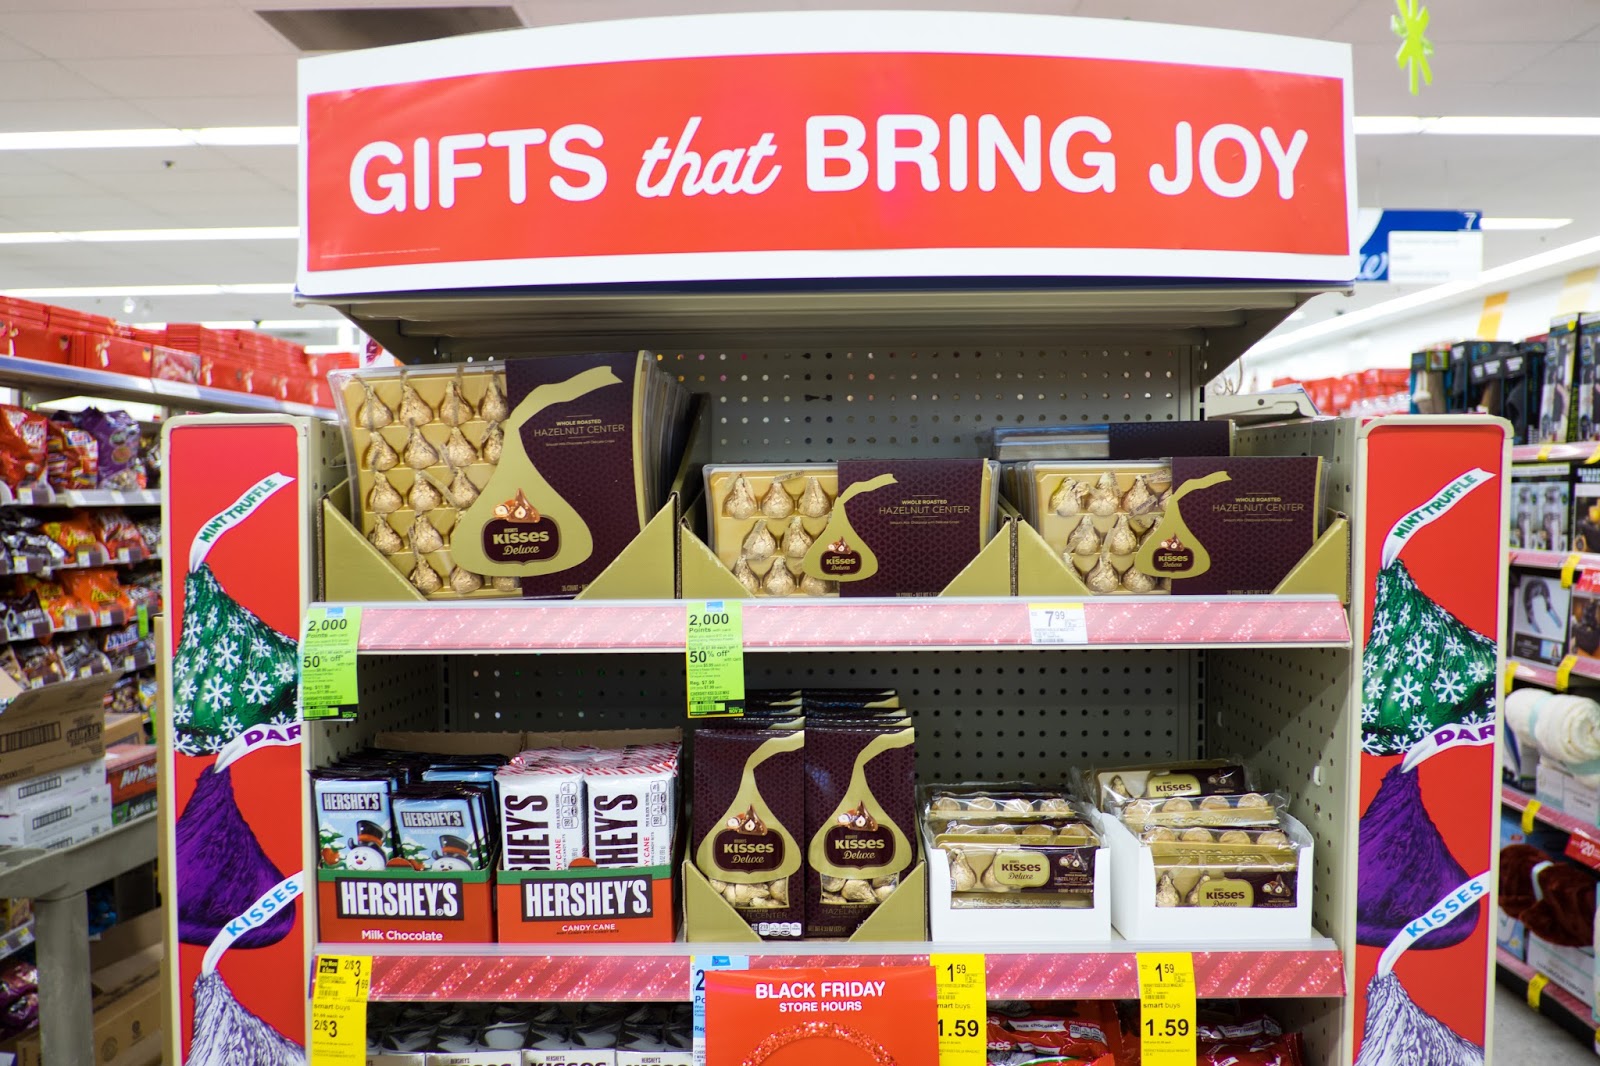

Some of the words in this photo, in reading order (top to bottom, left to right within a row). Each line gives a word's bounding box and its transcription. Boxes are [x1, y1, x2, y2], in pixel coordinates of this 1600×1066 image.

[350, 124, 608, 215] GIFTS
[635, 116, 782, 198] that
[805, 114, 1116, 193] BRING
[1148, 121, 1308, 200] JOY
[1463, 211, 1477, 231] 7
[534, 427, 584, 437] HAZELNUT
[587, 424, 625, 434] CENTER
[199, 515, 227, 544] MINT
[224, 479, 278, 521] TRUFFLE
[880, 506, 929, 514] HAZELNUT
[932, 505, 970, 514] CENTER
[1212, 504, 1263, 512] HAZELNUT
[1265, 504, 1304, 512] CENTER
[1393, 509, 1425, 540] MINT
[1423, 474, 1478, 517] TRUFFLE
[502, 544, 540, 556] Deluxe
[308, 618, 348, 633] 2,000
[689, 614, 729, 628] 2,000
[323, 793, 380, 811] HERSHEY'S
[403, 812, 462, 827] HERSHEY'S
[731, 854, 764, 864] Deluxe
[842, 850, 876, 860] Deluxe
[1008, 872, 1034, 880] Deluxe
[341, 881, 458, 917] HERSHEY'S
[525, 879, 648, 918] HERSHEY'S
[225, 880, 299, 937] KISSES
[1405, 880, 1483, 939] KISSES
[362, 930, 384, 940] Milk
[386, 930, 443, 941] Chocolate
[756, 982, 816, 1000] BLACK
[821, 981, 886, 998] FRIDAY
[779, 1002, 818, 1013] STORE
[822, 1001, 862, 1012] HOURS
[314, 1020, 338, 1038] 2/$3
[938, 1019, 979, 1037] 1.59
[1145, 1018, 1189, 1036] 1.59
